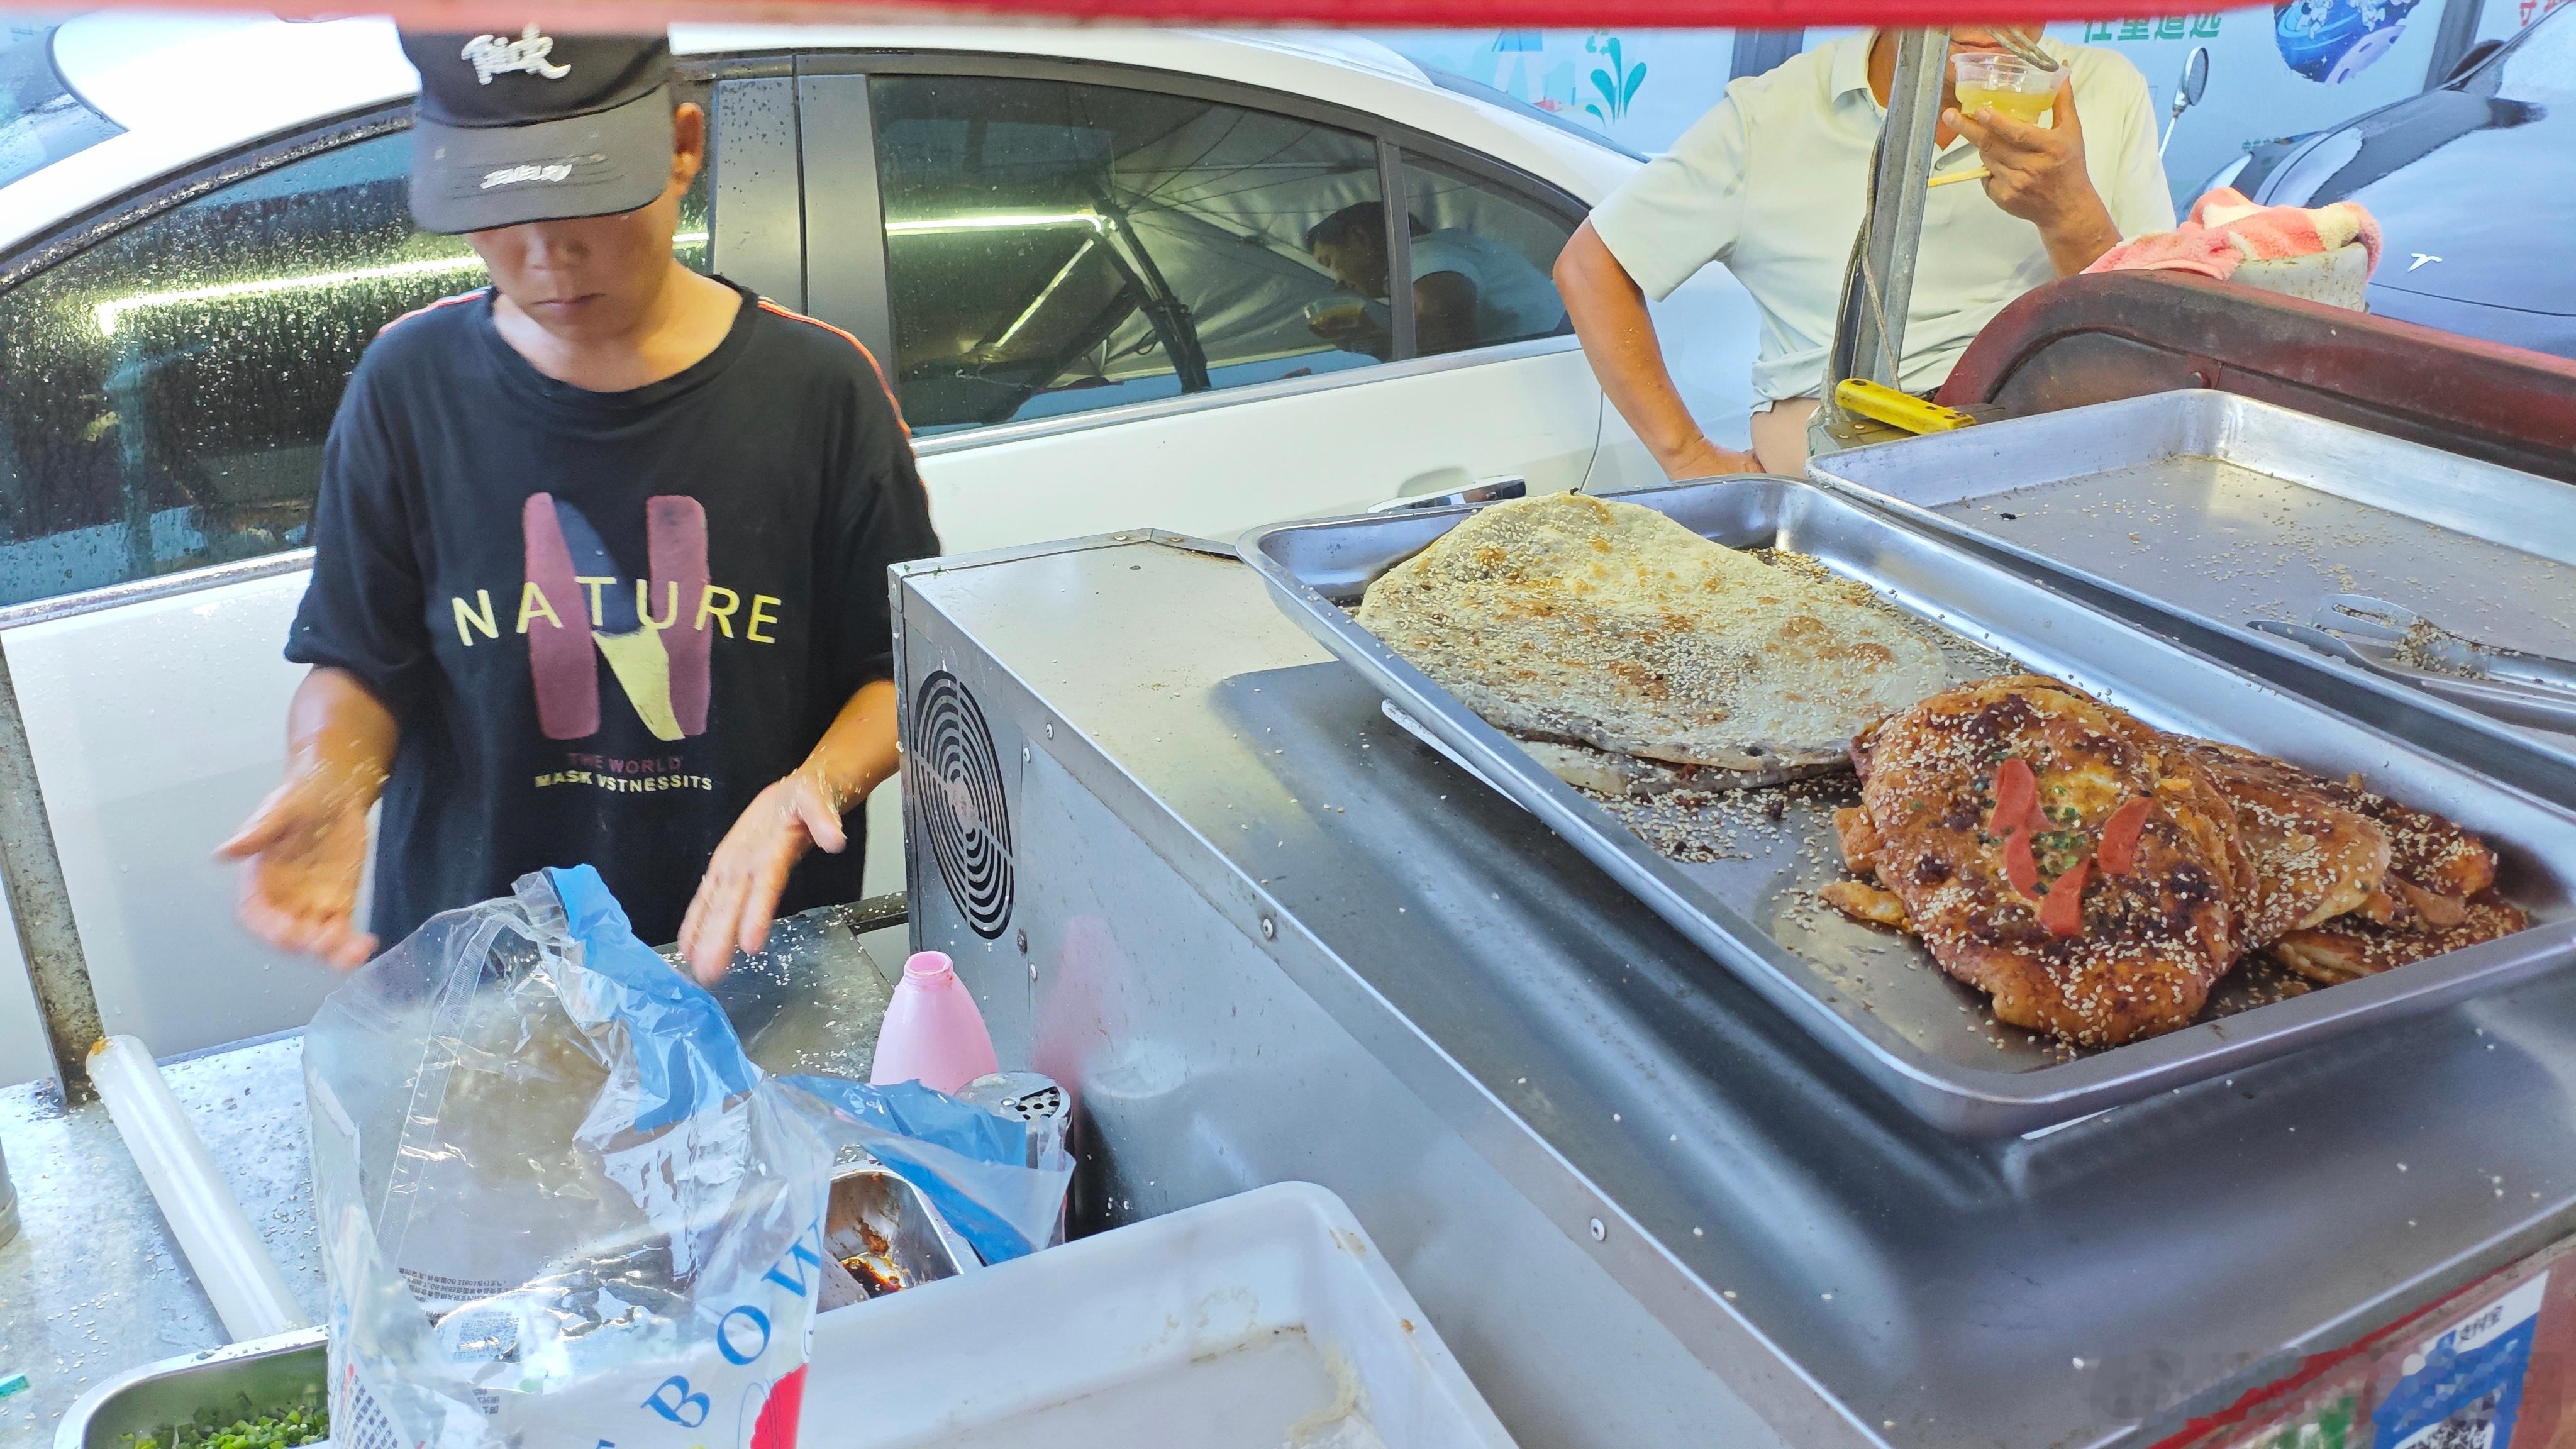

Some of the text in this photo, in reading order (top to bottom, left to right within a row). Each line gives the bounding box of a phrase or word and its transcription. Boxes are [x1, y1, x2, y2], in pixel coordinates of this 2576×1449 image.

[452, 576, 782, 647] NATURE
[608, 757, 682, 774] WORLD
[535, 770, 592, 788] MASK
